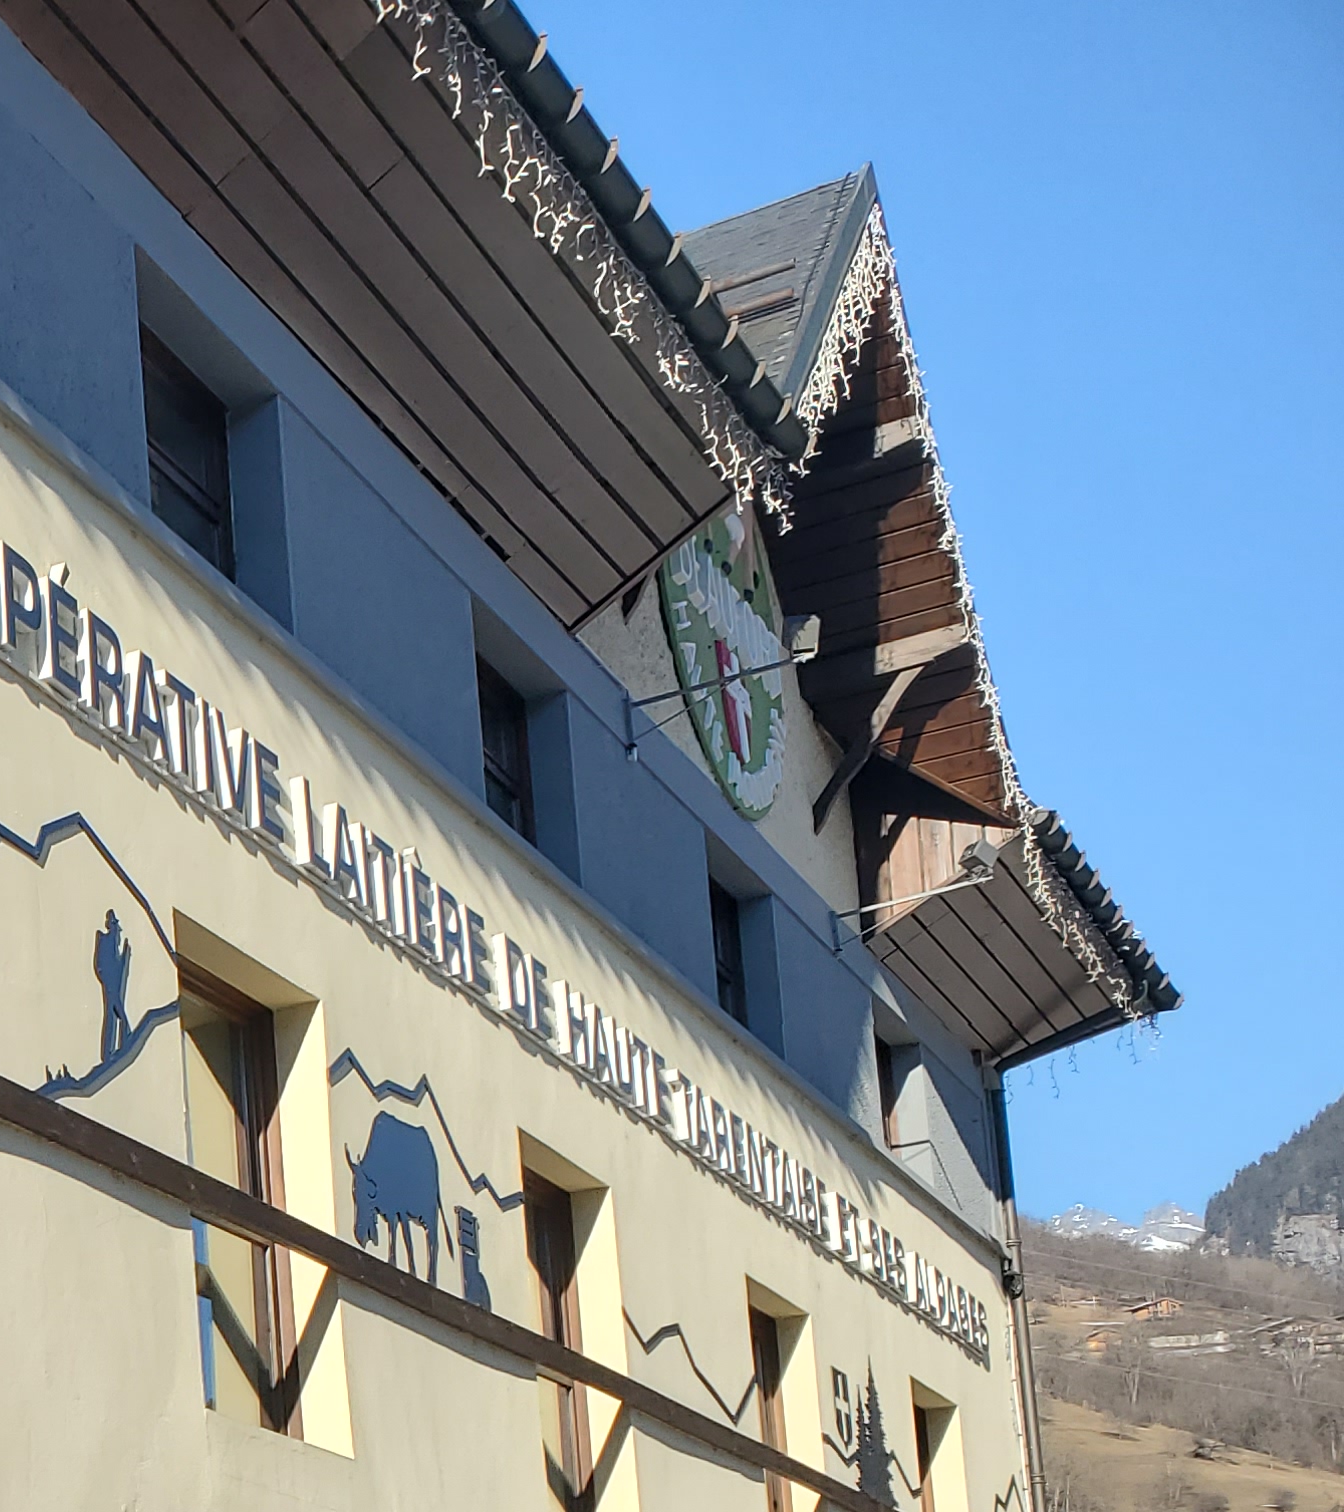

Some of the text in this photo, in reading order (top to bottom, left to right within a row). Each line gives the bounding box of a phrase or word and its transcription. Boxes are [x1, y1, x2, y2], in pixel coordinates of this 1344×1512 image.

[289, 776, 491, 995] LAITIÈRE
[492, 932, 551, 1041] DE
[552, 980, 671, 1125] HAUTE
[663, 1068, 829, 1242] TARENTAISE
[823, 1191, 861, 1263] ET
